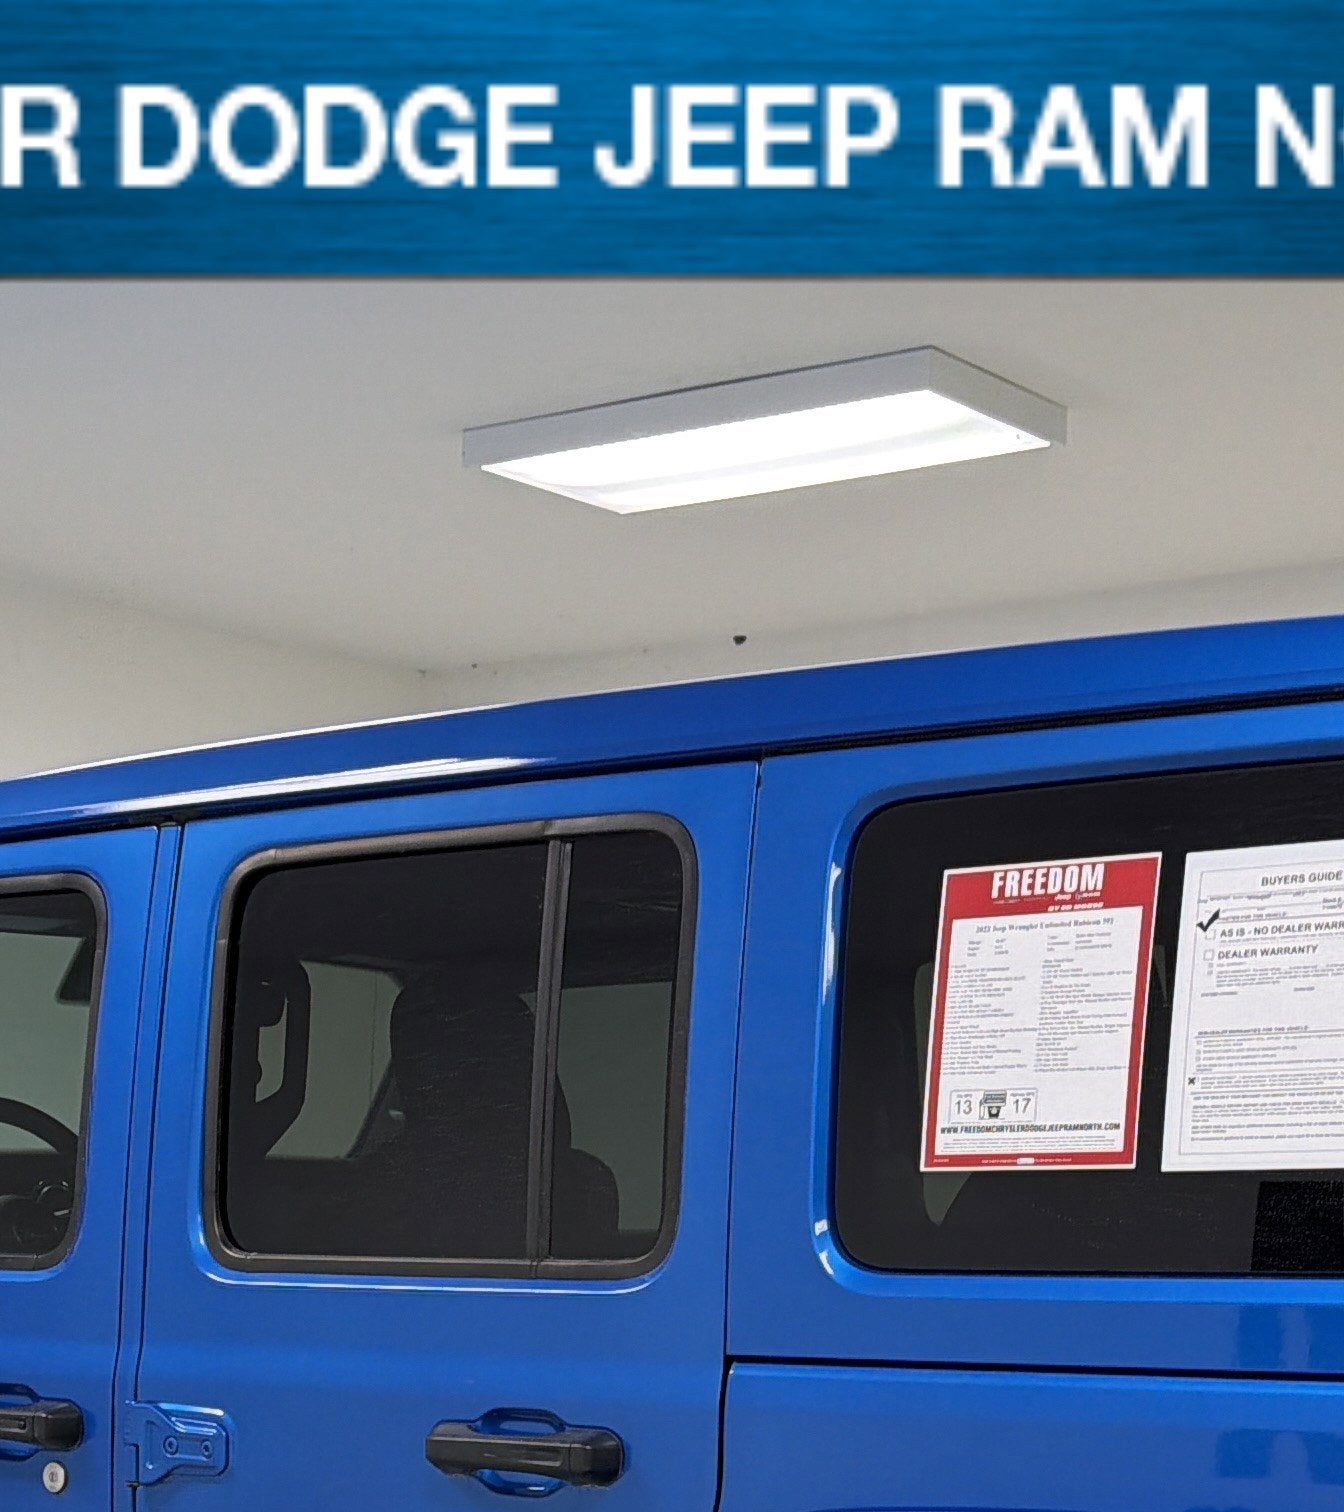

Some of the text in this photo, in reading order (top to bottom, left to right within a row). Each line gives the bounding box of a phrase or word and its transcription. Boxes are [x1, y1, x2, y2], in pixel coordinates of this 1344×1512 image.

[991, 863, 1105, 899] FREEDOM
[1261, 870, 1344, 887] BUYERS GUIDE
[1219, 927, 1234, 938] AS
[1235, 926, 1246, 937] IS
[1253, 925, 1269, 936] NO
[1270, 921, 1312, 935] DEALER
[1217, 944, 1319, 960] DEALER WARRANTY
[955, 1099, 973, 1116] 13
[1012, 1097, 1032, 1115] 17
